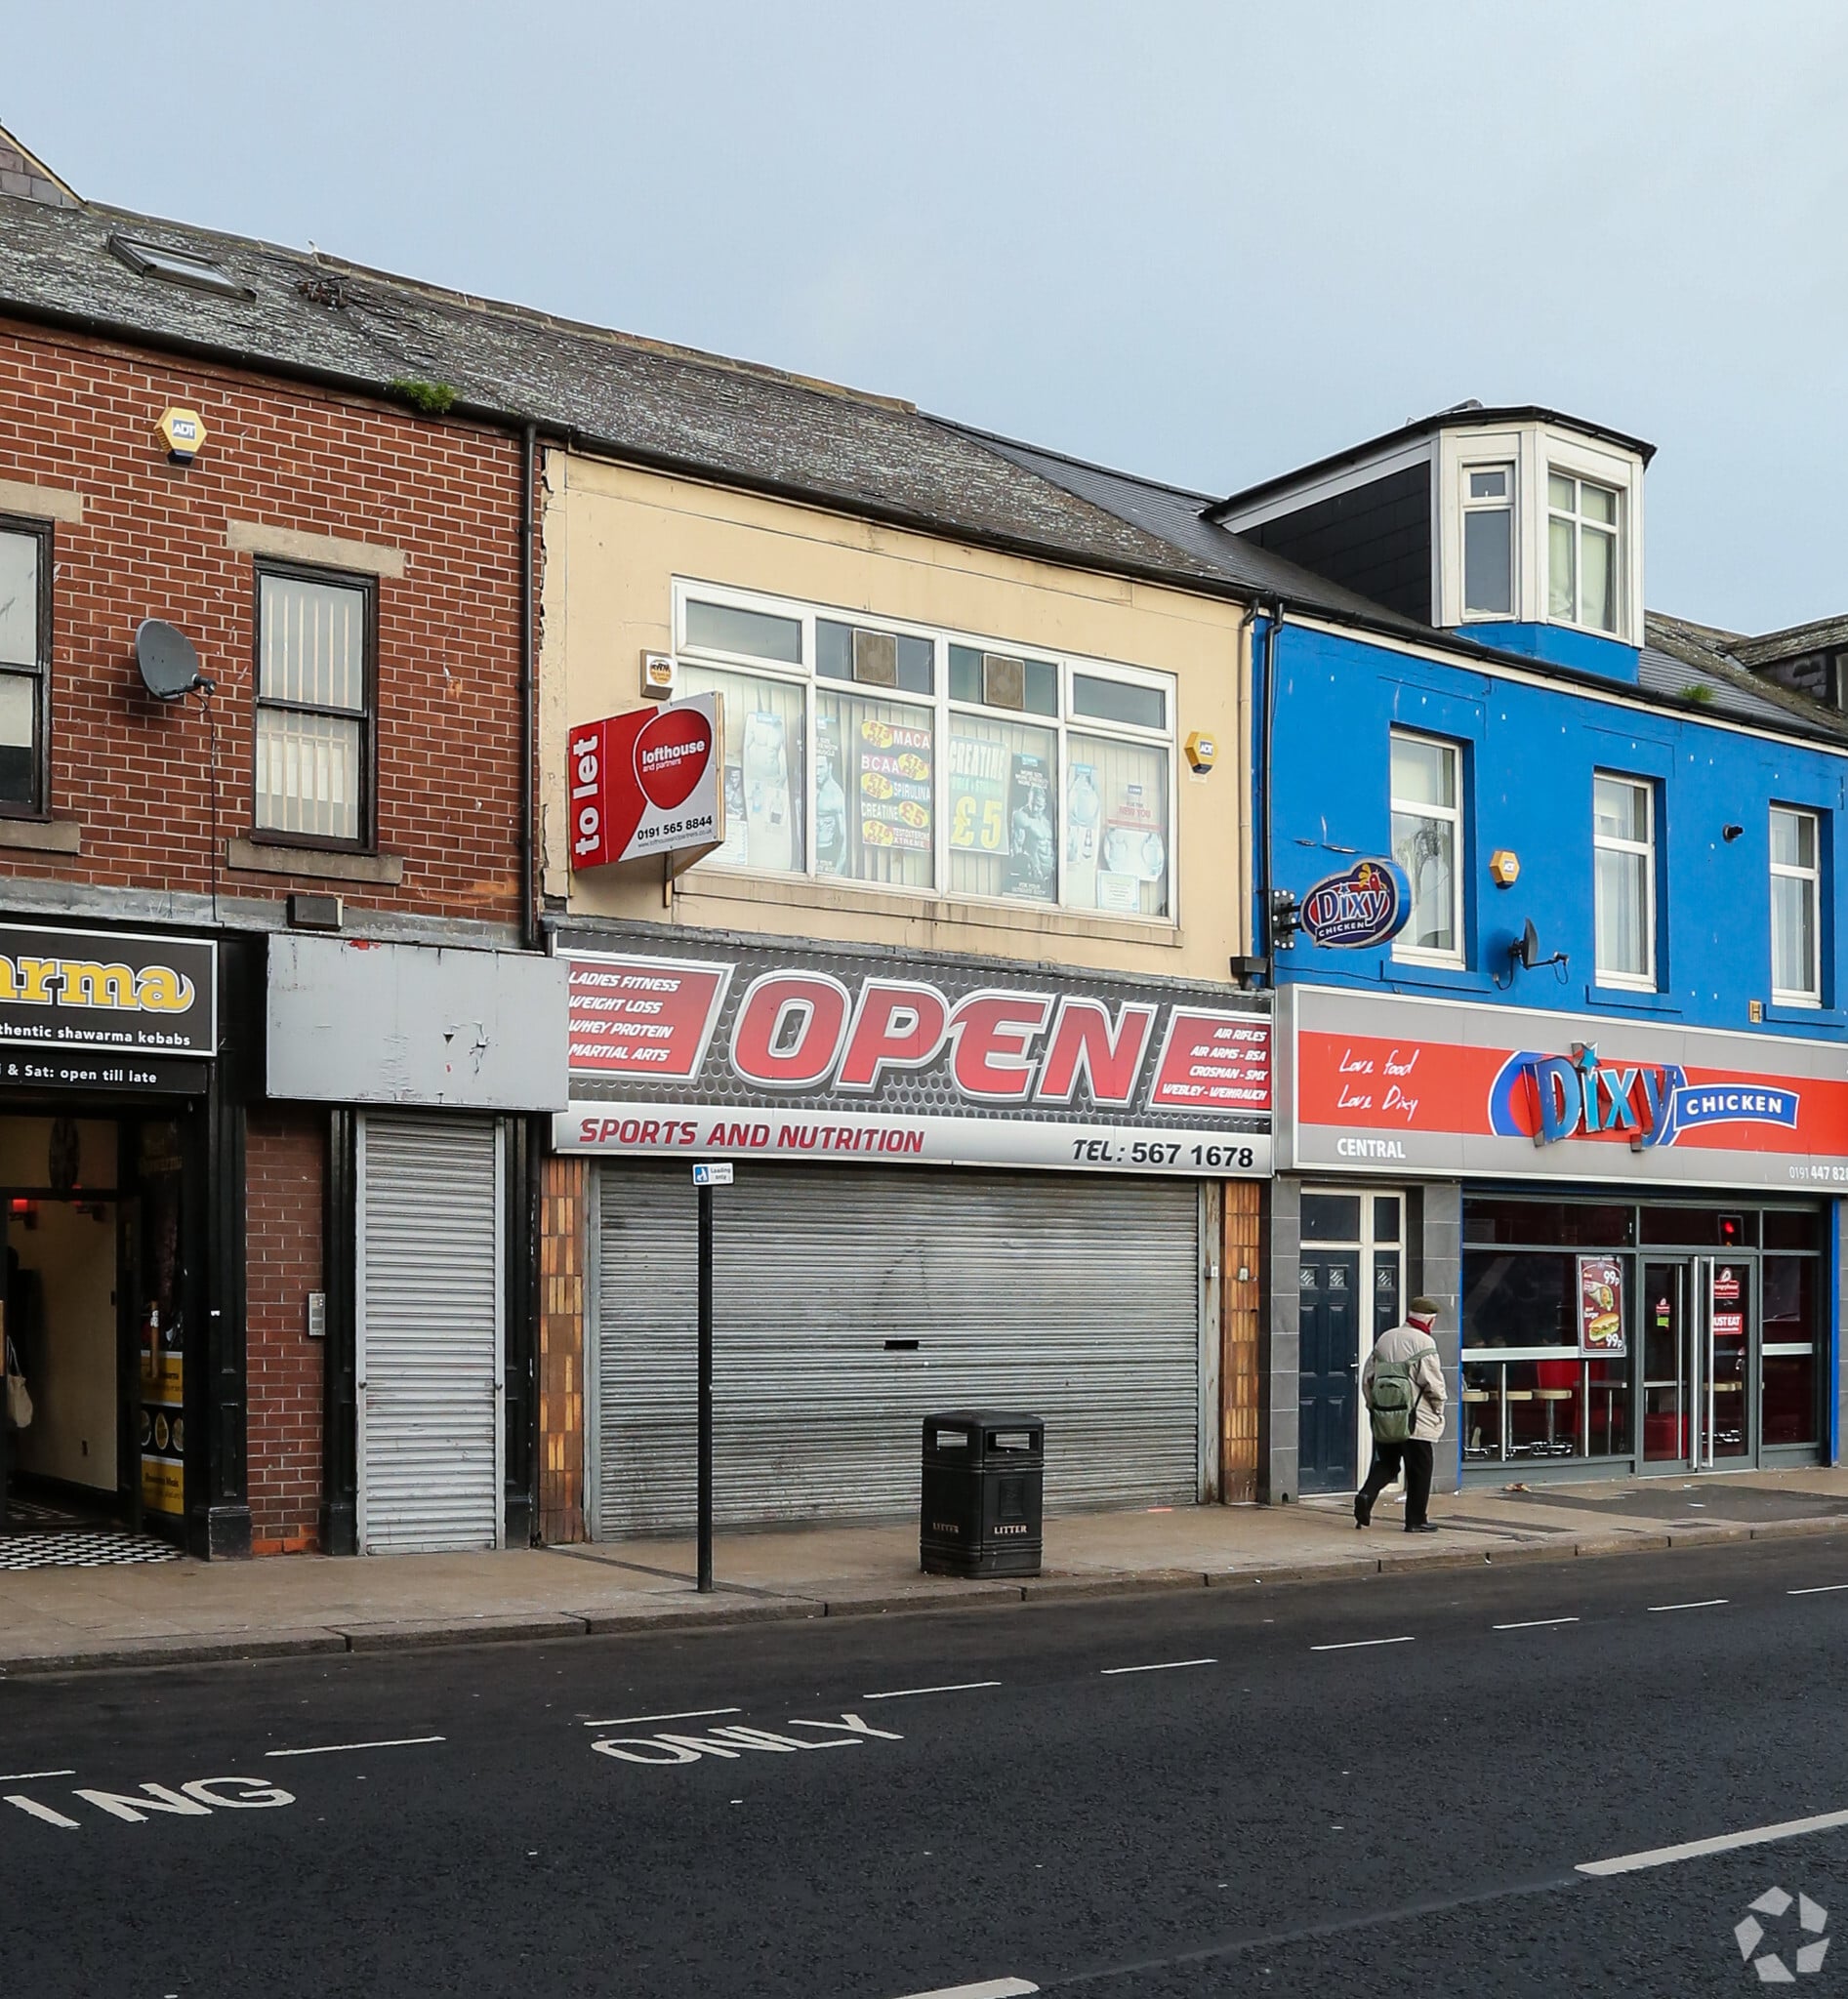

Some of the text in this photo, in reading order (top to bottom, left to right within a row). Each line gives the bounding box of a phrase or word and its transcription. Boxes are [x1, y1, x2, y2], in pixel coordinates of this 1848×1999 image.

[173, 423, 195, 437] ADT
[893, 730, 930, 750] MACA
[641, 740, 706, 765] lofthouse
[642, 757, 681, 773] and partners
[861, 755, 899, 773] BCAA
[573, 735, 599, 856] to let
[861, 802, 898, 821] CREATINE
[902, 801, 924, 827] £5
[637, 815, 712, 840] 0191 565 8844
[951, 796, 1003, 849] £5
[1319, 922, 1364, 937] CHICKEN
[569, 971, 680, 992] LADIES FITNESS
[569, 995, 663, 1014] WEIGHT LOSS
[58, 1026, 133, 1041] shawarma
[138, 1030, 190, 1046] kebabs
[569, 1019, 674, 1039] WHEY PROTEIN
[1213, 1028, 1267, 1042] AIR RIFLES
[728, 969, 1160, 1110] OPEN
[569, 1043, 671, 1062] MARTIAL ARTS
[1190, 1045, 1210, 1057] AIR
[1210, 1047, 1240, 1060] ARMS
[1245, 1050, 1266, 1062] BSA
[1338, 1048, 1420, 1077] Love food
[8, 1063, 19, 1077] &
[24, 1064, 55, 1078] Sat:
[61, 1069, 97, 1081] open
[103, 1069, 123, 1081] till
[129, 1070, 157, 1083] late
[1189, 1065, 1240, 1080] CROSMAN
[1162, 1083, 1205, 1097] WEBLEY
[1337, 1083, 1418, 1122] Love Dixy
[1687, 1094, 1783, 1116] CHICKEN
[578, 1118, 925, 1153] SPORTS AND NUTRITION
[1131, 1142, 1181, 1164] 567
[1191, 1145, 1253, 1167] 1678
[1337, 1137, 1406, 1159] CENTRAL
[1789, 1165, 1809, 1180] 0191
[1811, 1165, 1830, 1180] 447
[1603, 1270, 1620, 1286] 99p
[1606, 1333, 1622, 1349] 99p
[932, 1523, 959, 1533] LITTER
[993, 1525, 1027, 1534] LITTER
[592, 1714, 903, 1765] ONLY
